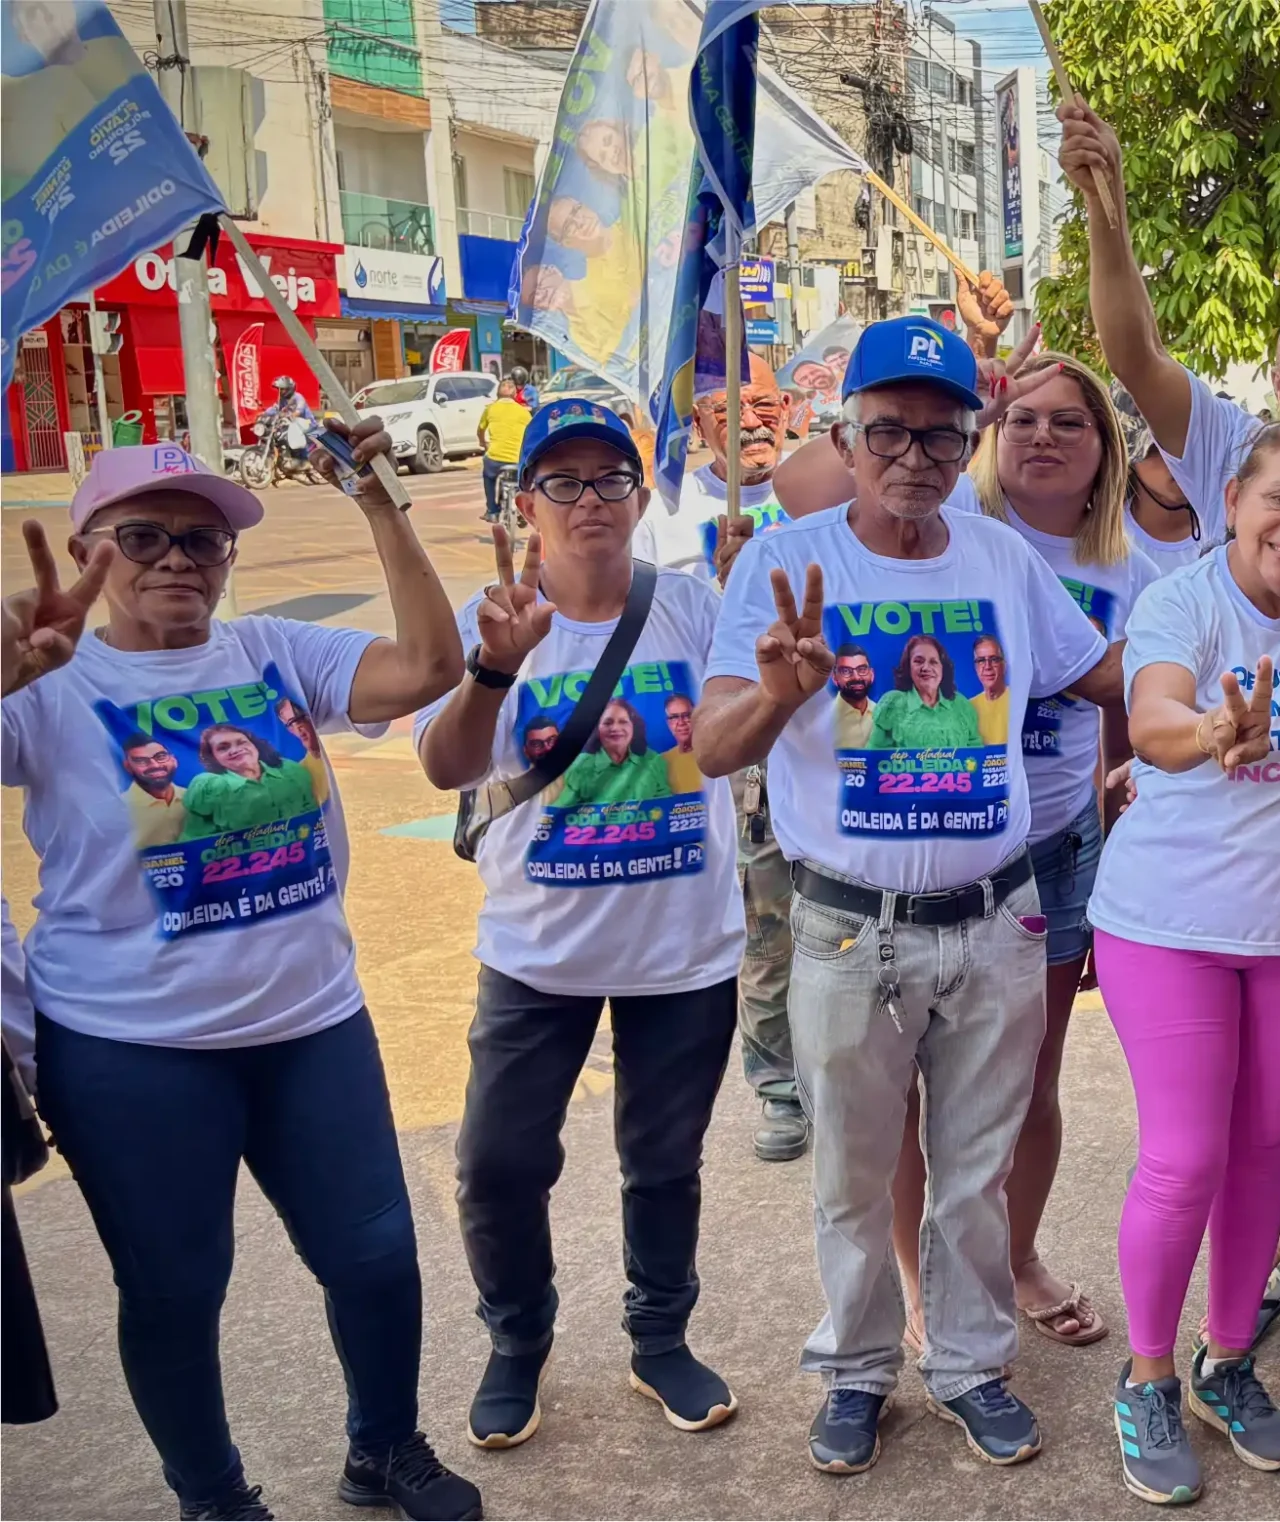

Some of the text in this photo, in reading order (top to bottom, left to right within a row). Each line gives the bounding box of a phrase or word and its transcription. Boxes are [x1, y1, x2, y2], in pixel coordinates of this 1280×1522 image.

[134, 252, 228, 296] Ota
[369, 268, 398, 286] norte
[910, 335, 941, 360] PL
[838, 599, 984, 637] VOTE!
[1042, 735, 1056, 748] PL
[878, 758, 966, 774] ODILEIDA
[982, 757, 1008, 768] JOAQU
[845, 774, 866, 788] 20
[878, 772, 972, 794] 22.245
[564, 809, 650, 827] ODILEIDA
[669, 816, 708, 833] 2222
[841, 803, 995, 831] ODILEIDA É DA GENTE!
[563, 822, 656, 845] 22.245
[200, 831, 296, 864] ODILEIDA
[687, 848, 703, 863] PL
[143, 856, 188, 869] DANIEL
[202, 841, 306, 886] 22.245
[527, 847, 683, 880] ODILEIDA É DA GENTE!
[153, 873, 184, 889] 20
[163, 867, 327, 932] ODILEIDA É DA GENTE!
